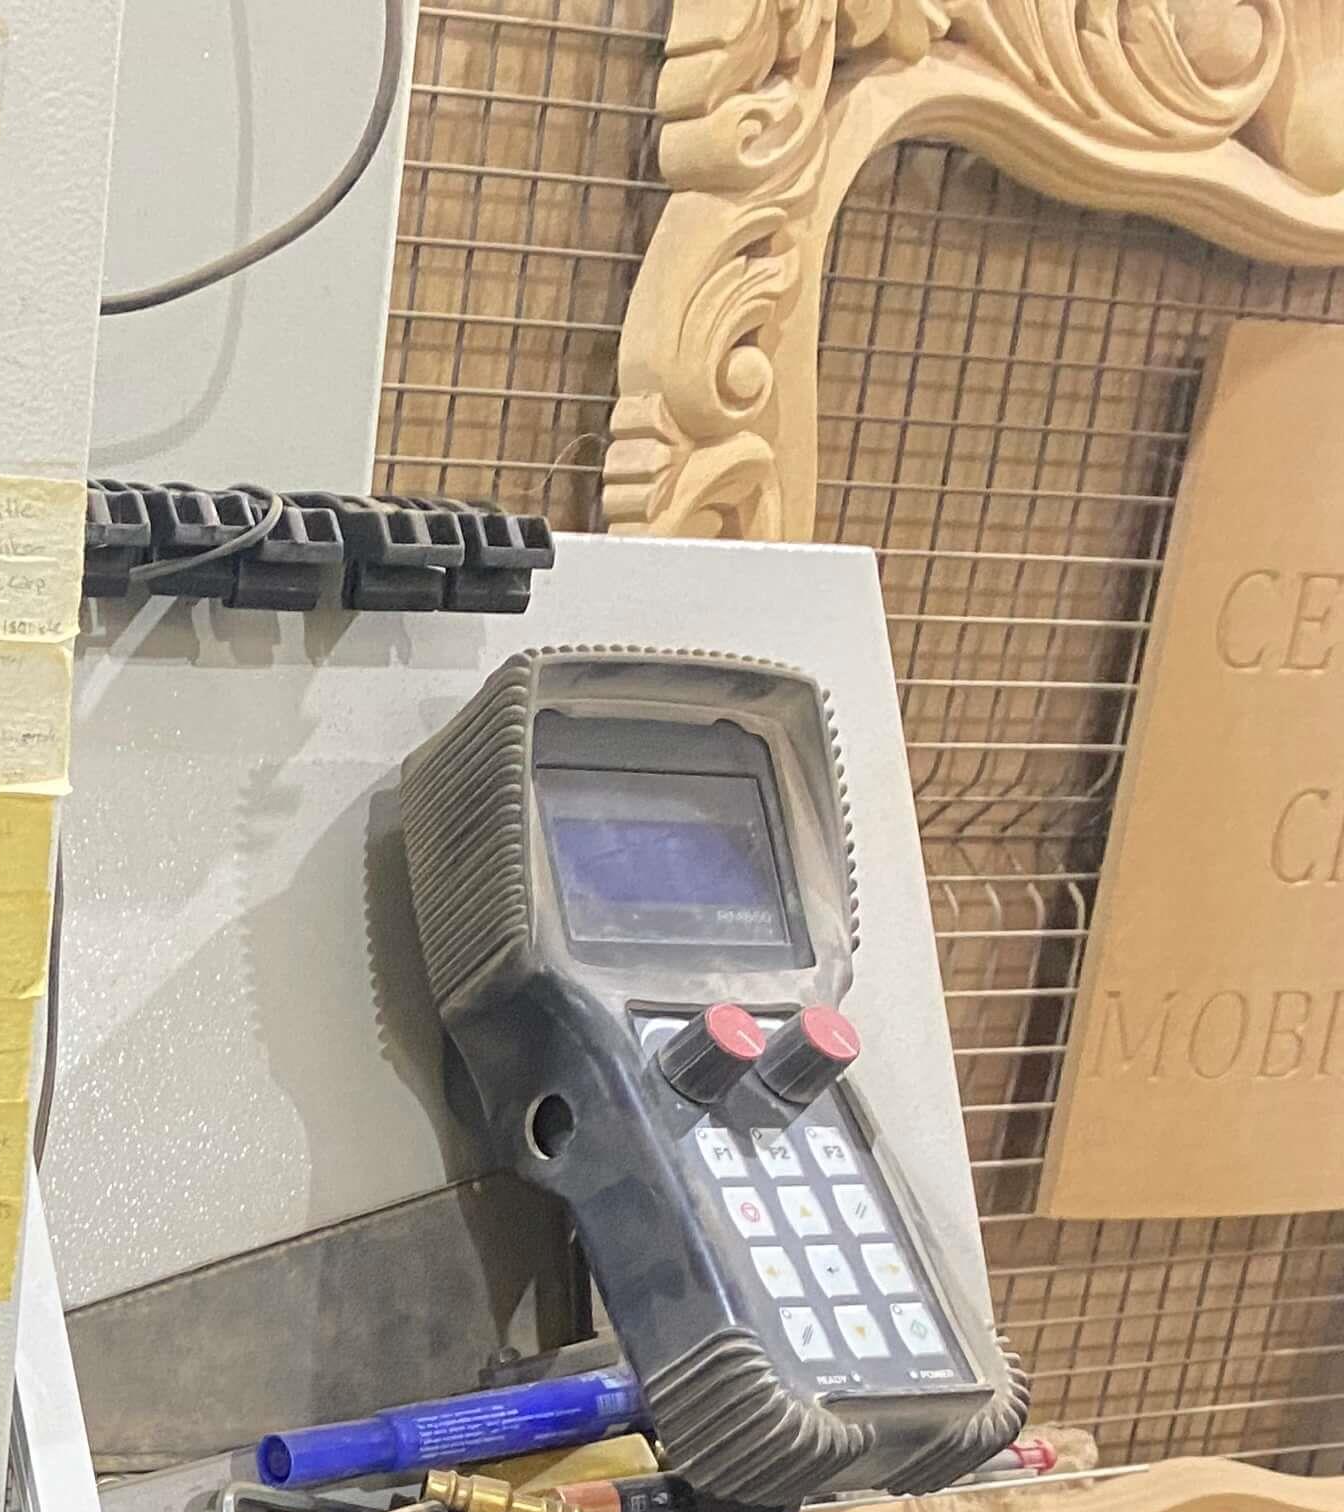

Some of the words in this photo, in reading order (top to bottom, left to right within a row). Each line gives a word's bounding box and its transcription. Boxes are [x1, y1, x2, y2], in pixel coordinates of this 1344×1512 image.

[713, 1146, 735, 1162] F1
[768, 1145, 792, 1161] F2
[823, 1143, 847, 1160] F3
